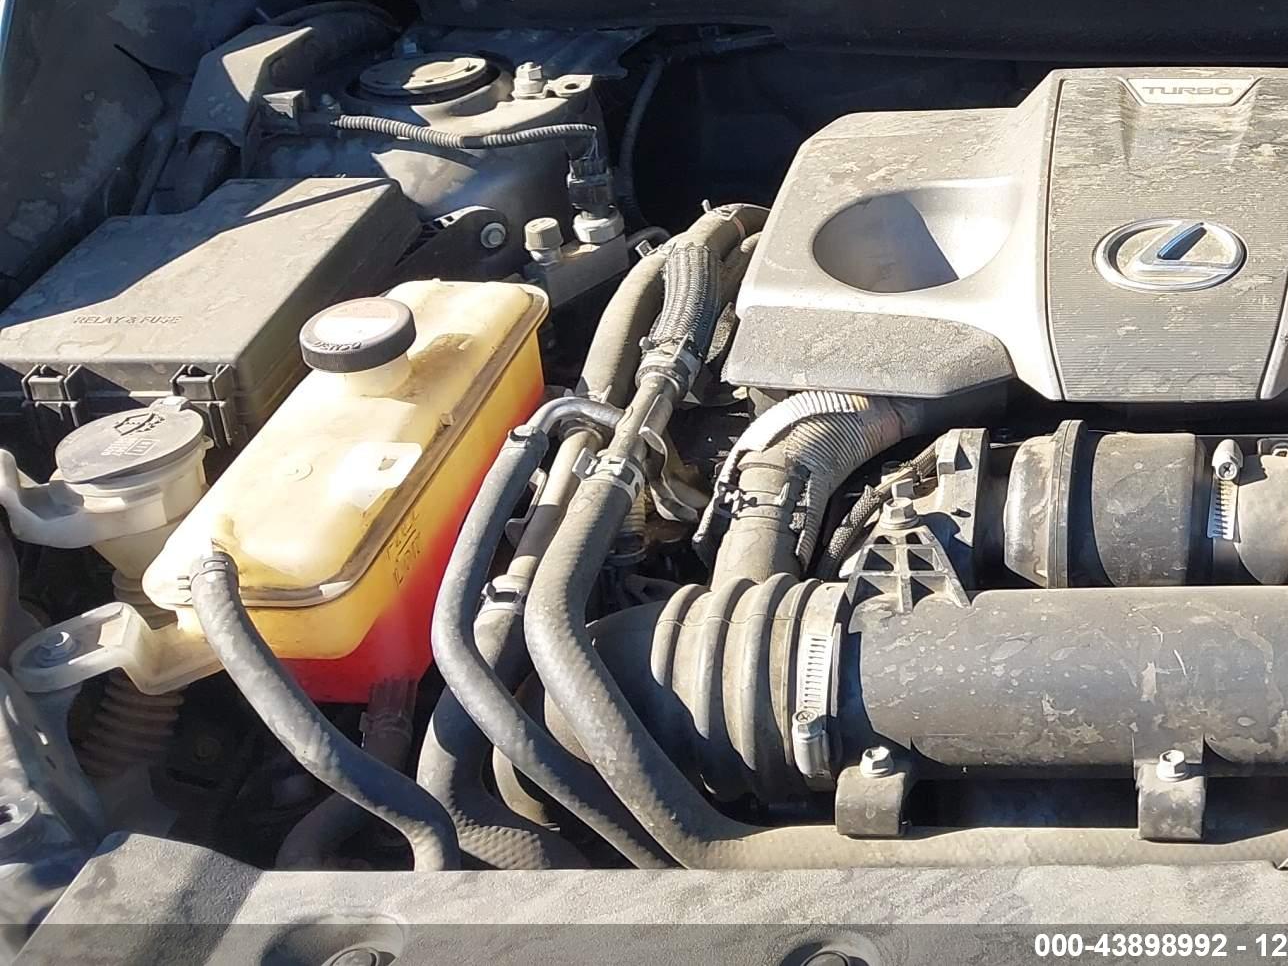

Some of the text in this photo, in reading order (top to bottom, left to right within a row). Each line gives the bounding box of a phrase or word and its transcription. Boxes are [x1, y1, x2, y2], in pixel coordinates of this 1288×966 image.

[1142, 86, 1234, 95] TURBO
[73, 315, 125, 324] RELAY
[140, 316, 183, 324] FUSE
